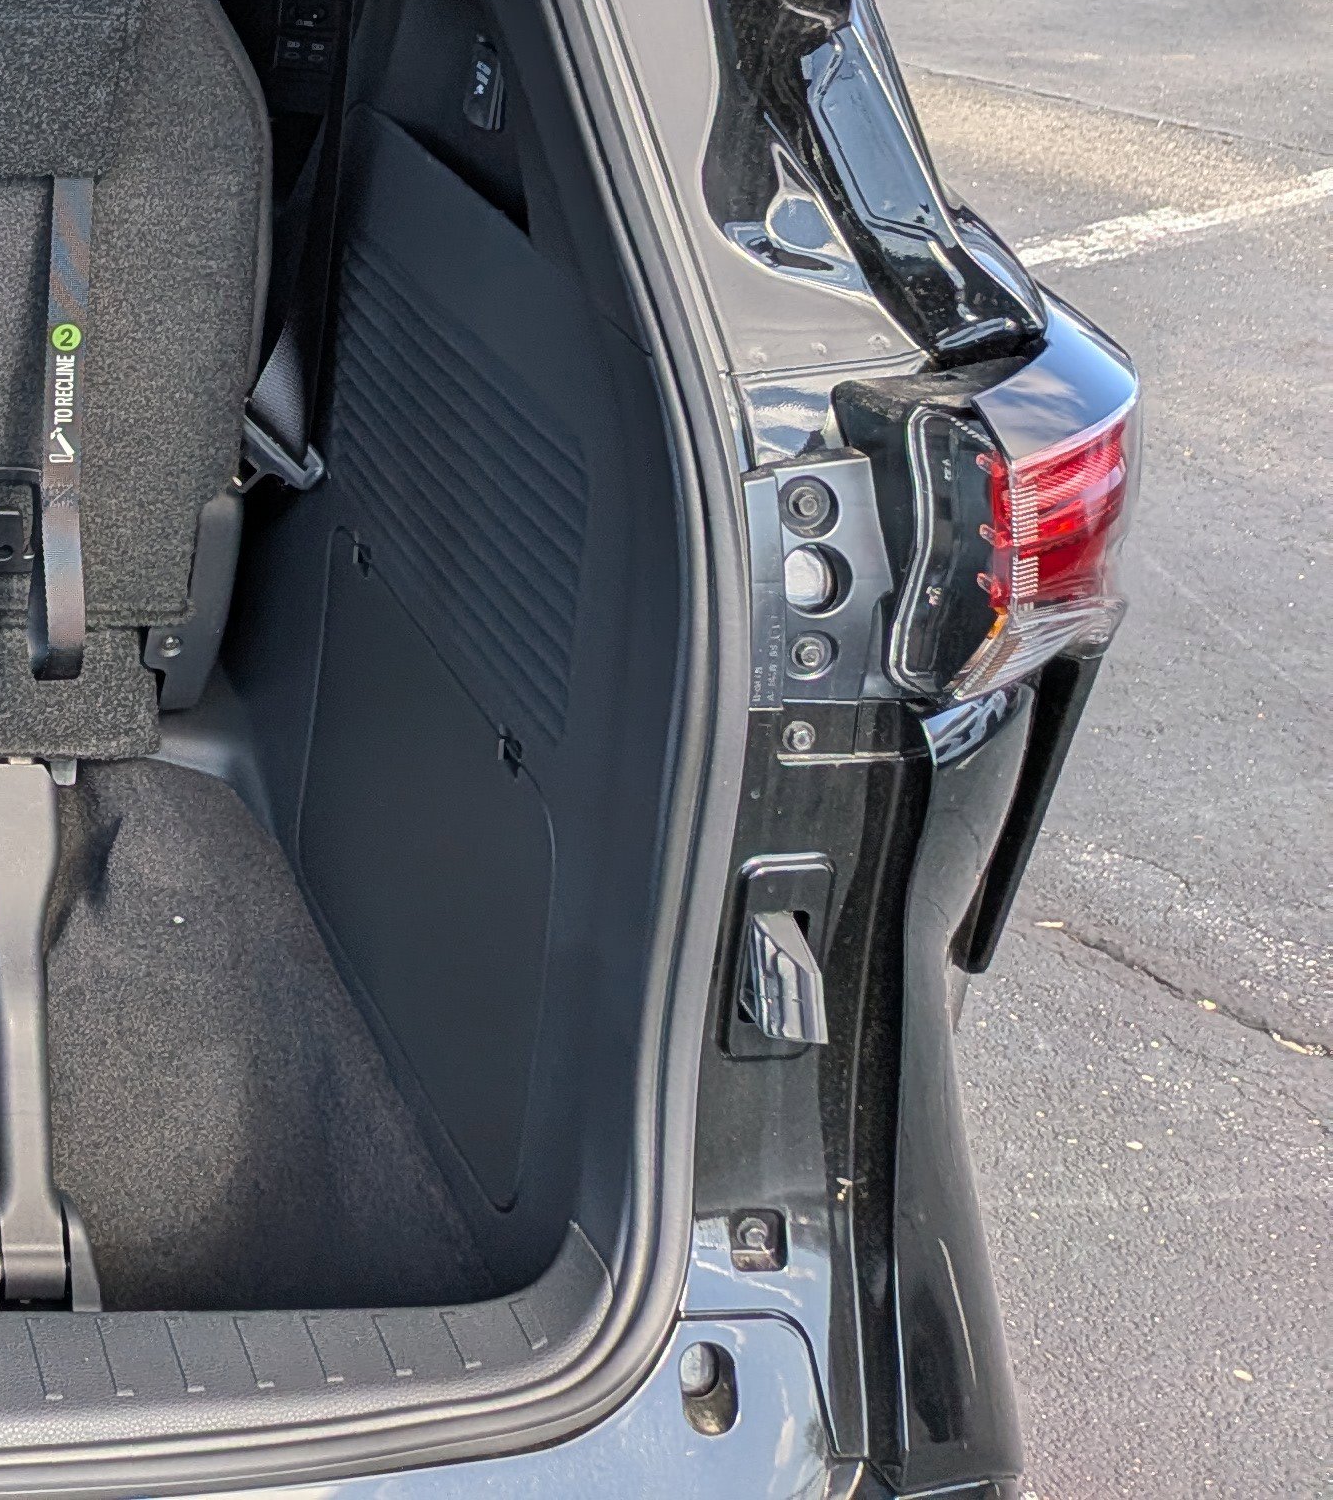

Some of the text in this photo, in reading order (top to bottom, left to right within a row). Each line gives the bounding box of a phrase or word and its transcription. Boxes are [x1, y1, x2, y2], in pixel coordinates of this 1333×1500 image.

[59, 328, 73, 347] 2
[54, 354, 75, 425] TO RECLINE
